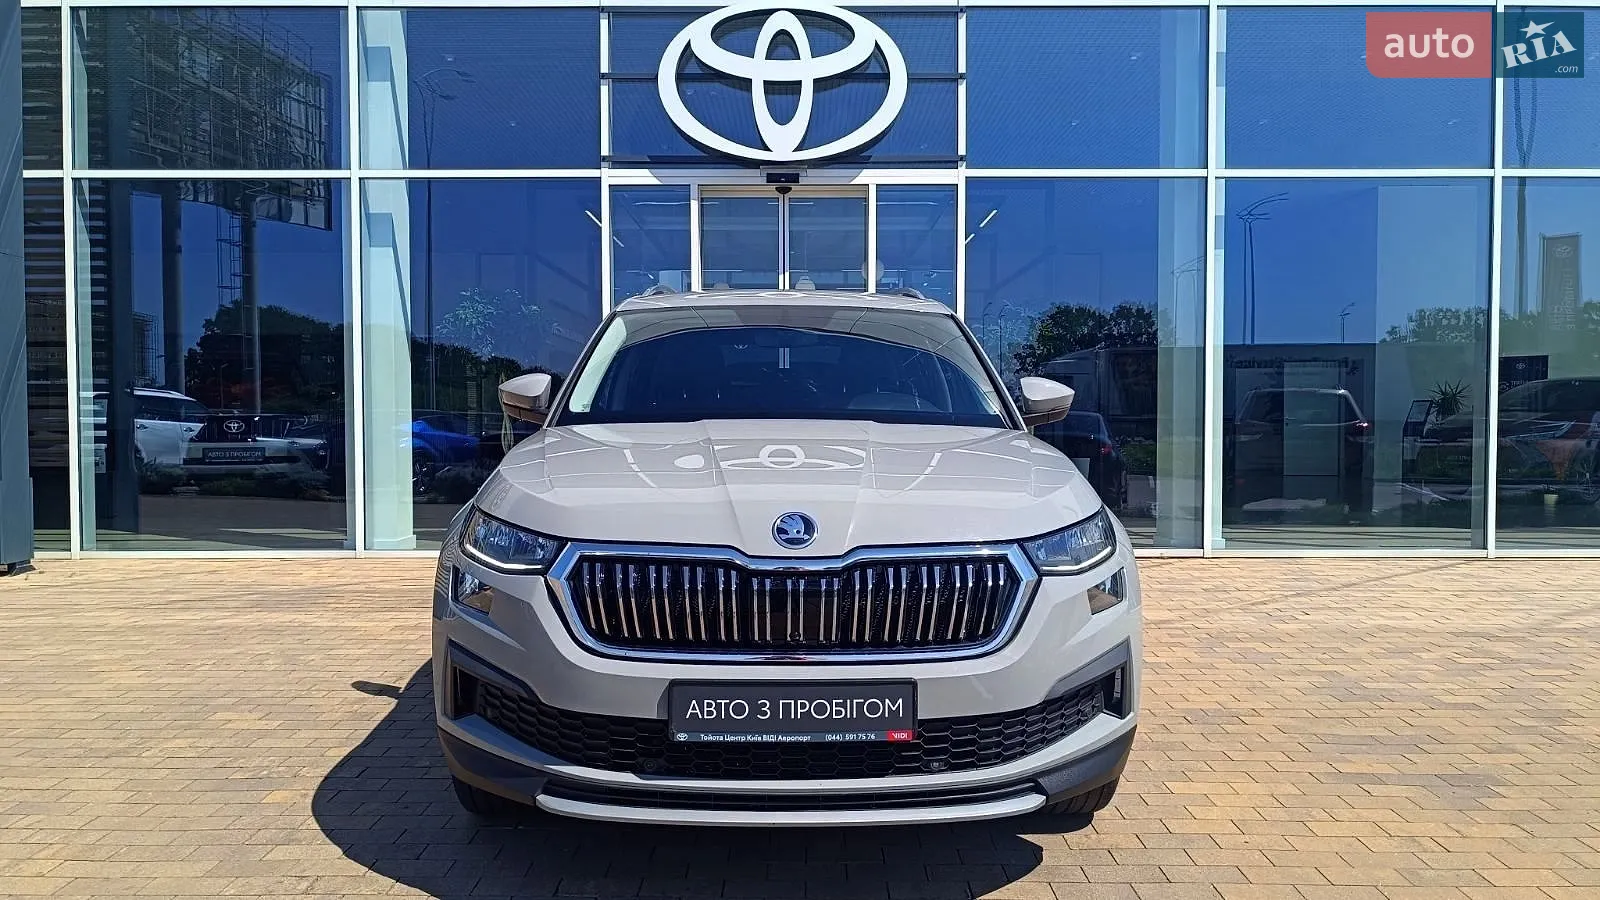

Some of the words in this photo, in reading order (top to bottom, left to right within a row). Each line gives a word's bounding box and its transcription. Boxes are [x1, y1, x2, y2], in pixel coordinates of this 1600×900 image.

[685, 699, 749, 720] АВТО
[756, 699, 771, 720] З
[779, 697, 903, 720] ПРОБІГОМ
[700, 734, 723, 742] Тойота
[724, 734, 746, 743] Центр
[747, 733, 762, 742] Київ
[825, 733, 843, 742] (044)
[845, 733, 857, 741] 591
